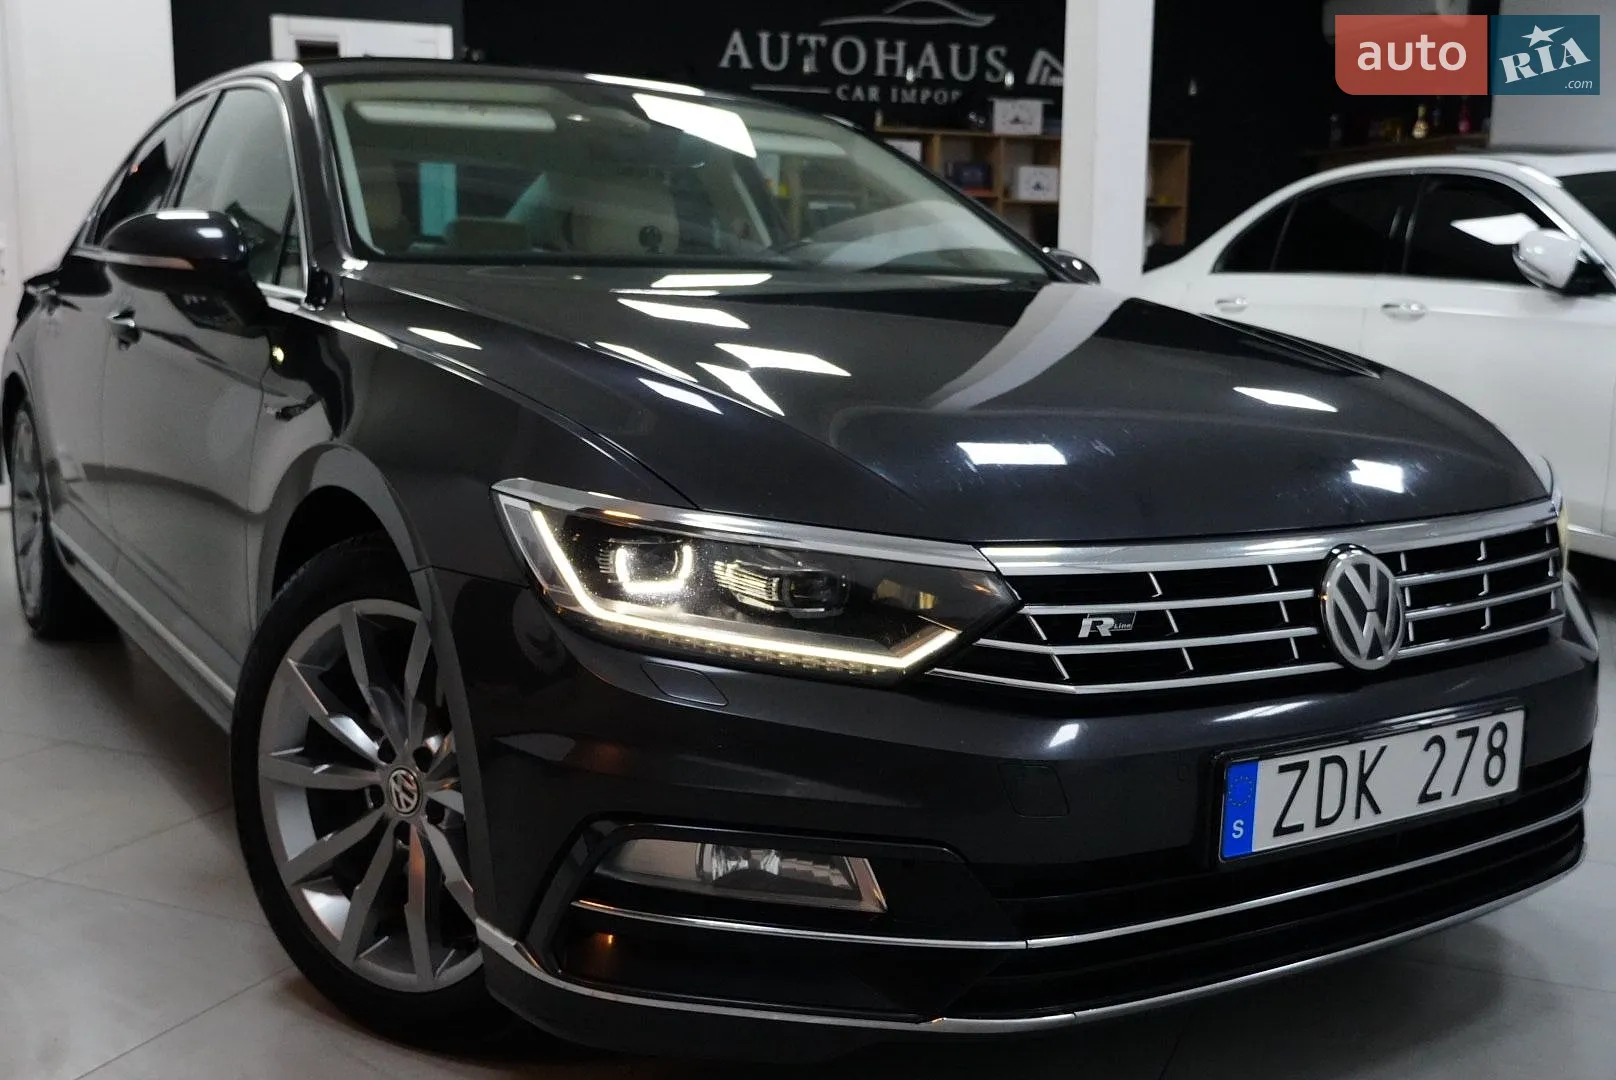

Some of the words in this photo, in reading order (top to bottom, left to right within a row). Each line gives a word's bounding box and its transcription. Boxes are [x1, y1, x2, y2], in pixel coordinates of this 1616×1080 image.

[718, 29, 1008, 84] AUTOHAUS
[836, 85, 880, 103] CAR
[1272, 745, 1388, 838] ZDK
[1417, 721, 1509, 805] 278
[1231, 820, 1244, 839] S
